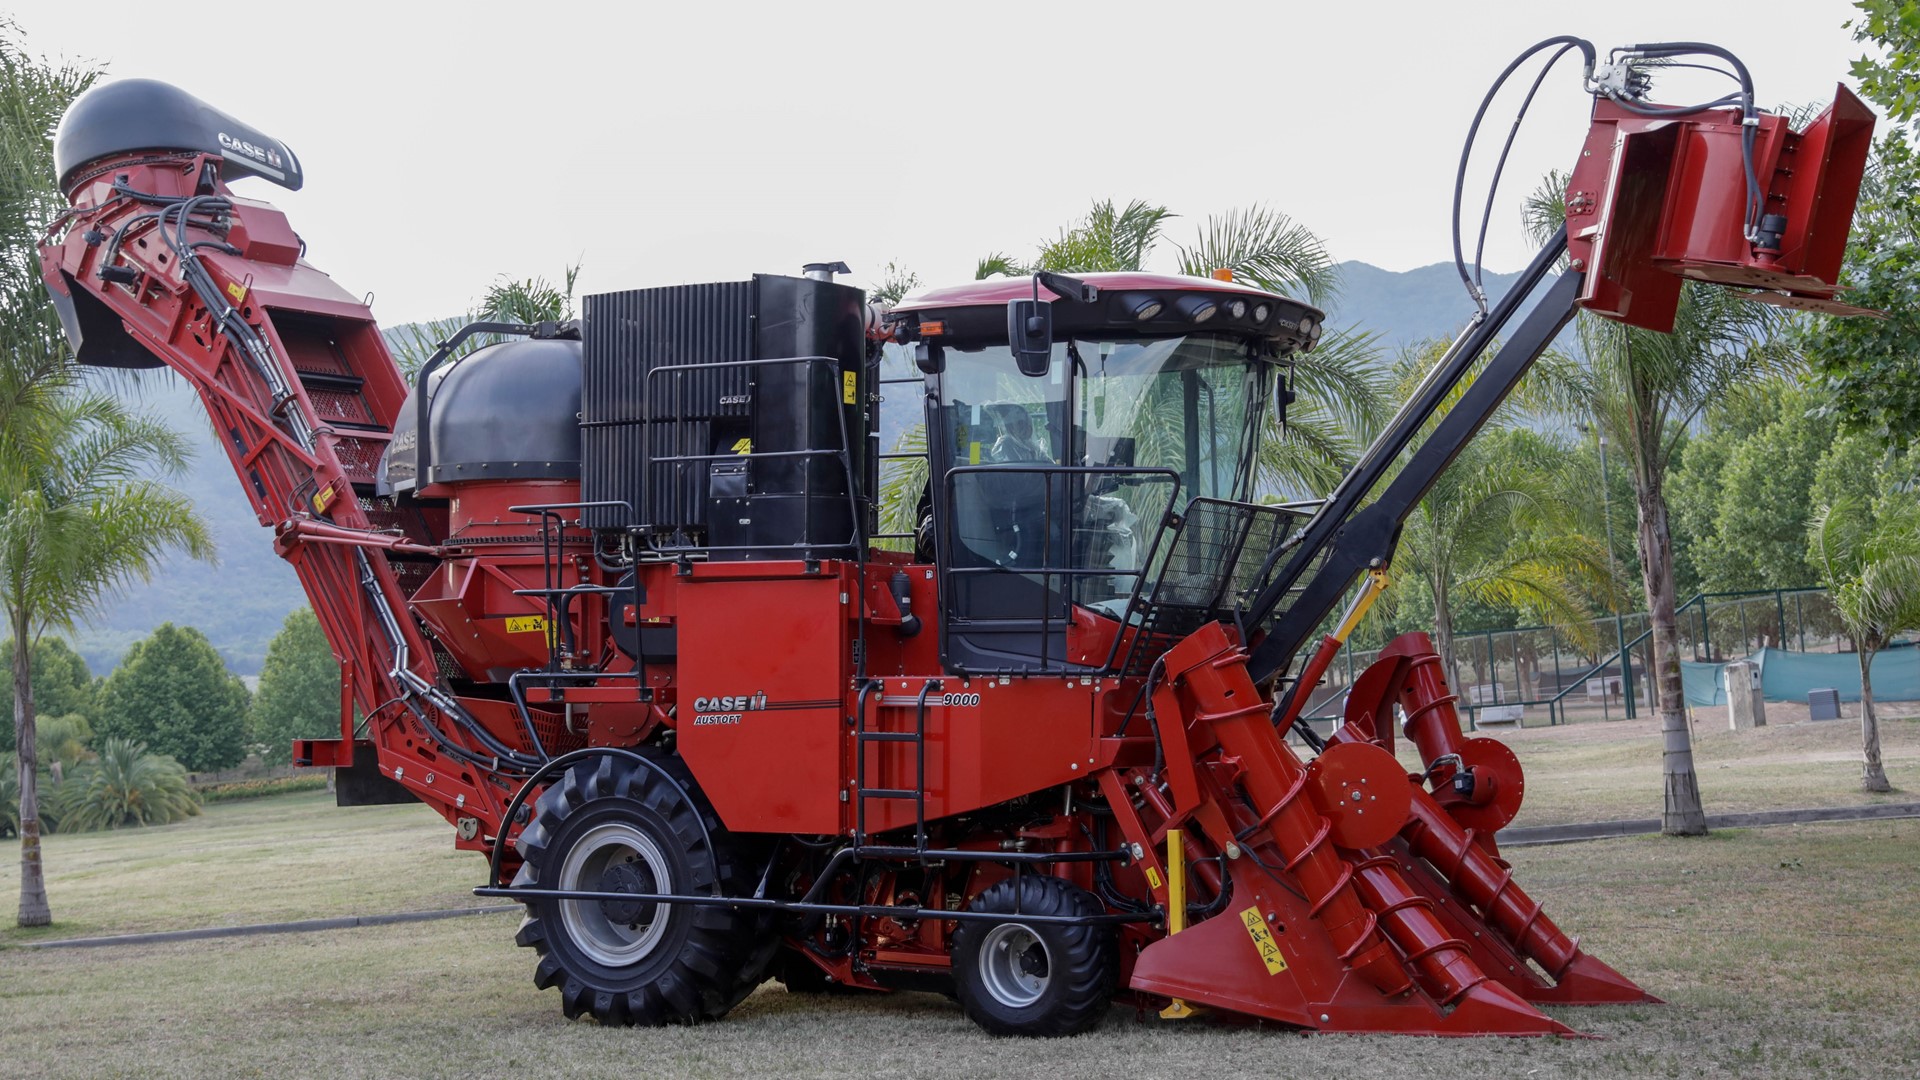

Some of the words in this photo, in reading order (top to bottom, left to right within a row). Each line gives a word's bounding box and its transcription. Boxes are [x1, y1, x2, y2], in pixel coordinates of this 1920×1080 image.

[218, 132, 266, 162] CASE
[720, 396, 745, 404] CASE
[694, 696, 748, 712] CASE
[943, 692, 980, 707] 9000
[694, 714, 742, 725] AUSTOFT
